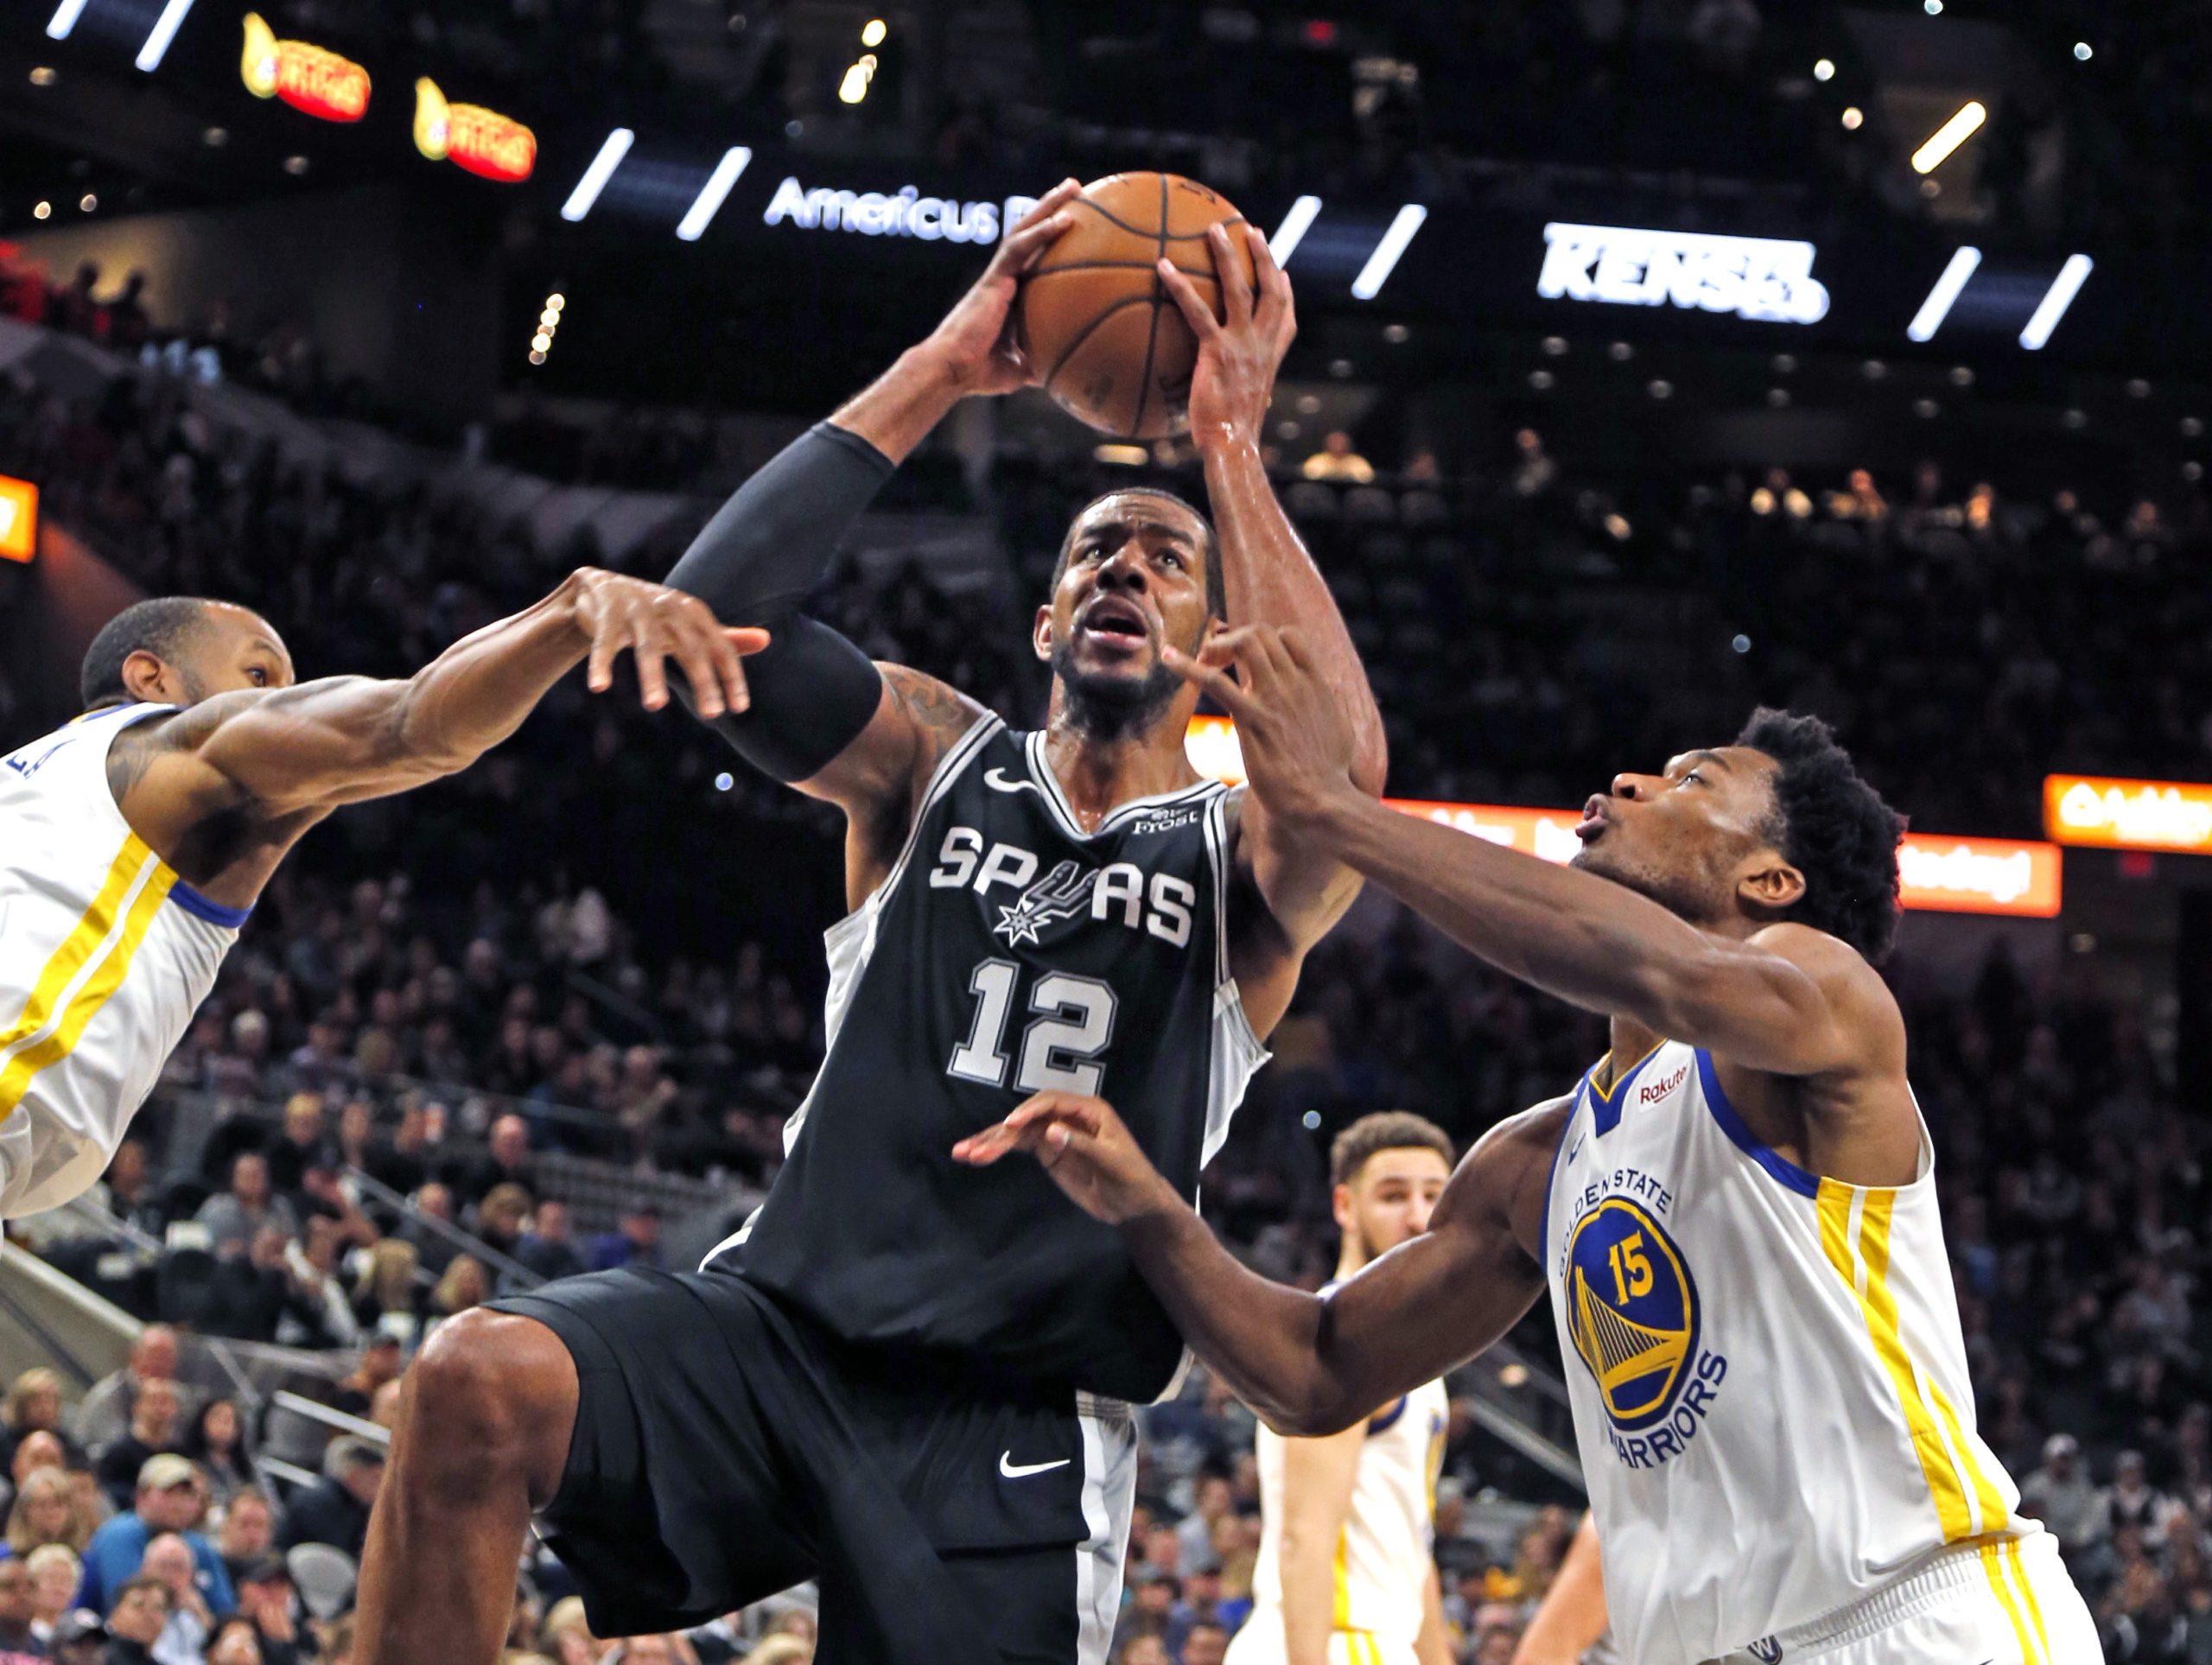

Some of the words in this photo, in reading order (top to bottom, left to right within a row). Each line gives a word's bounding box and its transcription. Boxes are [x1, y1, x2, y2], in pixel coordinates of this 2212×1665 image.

[765, 175, 1000, 245] Americus
[1132, 810, 1198, 835] Frost
[930, 827, 1196, 949] SPURS
[946, 956, 1120, 1097] 12
[1640, 1065, 1688, 1104] Rakute
[1614, 1168, 1672, 1215] STATE
[1609, 1230, 1654, 1306] 15
[1605, 1350, 1728, 1470] WARRIORS
